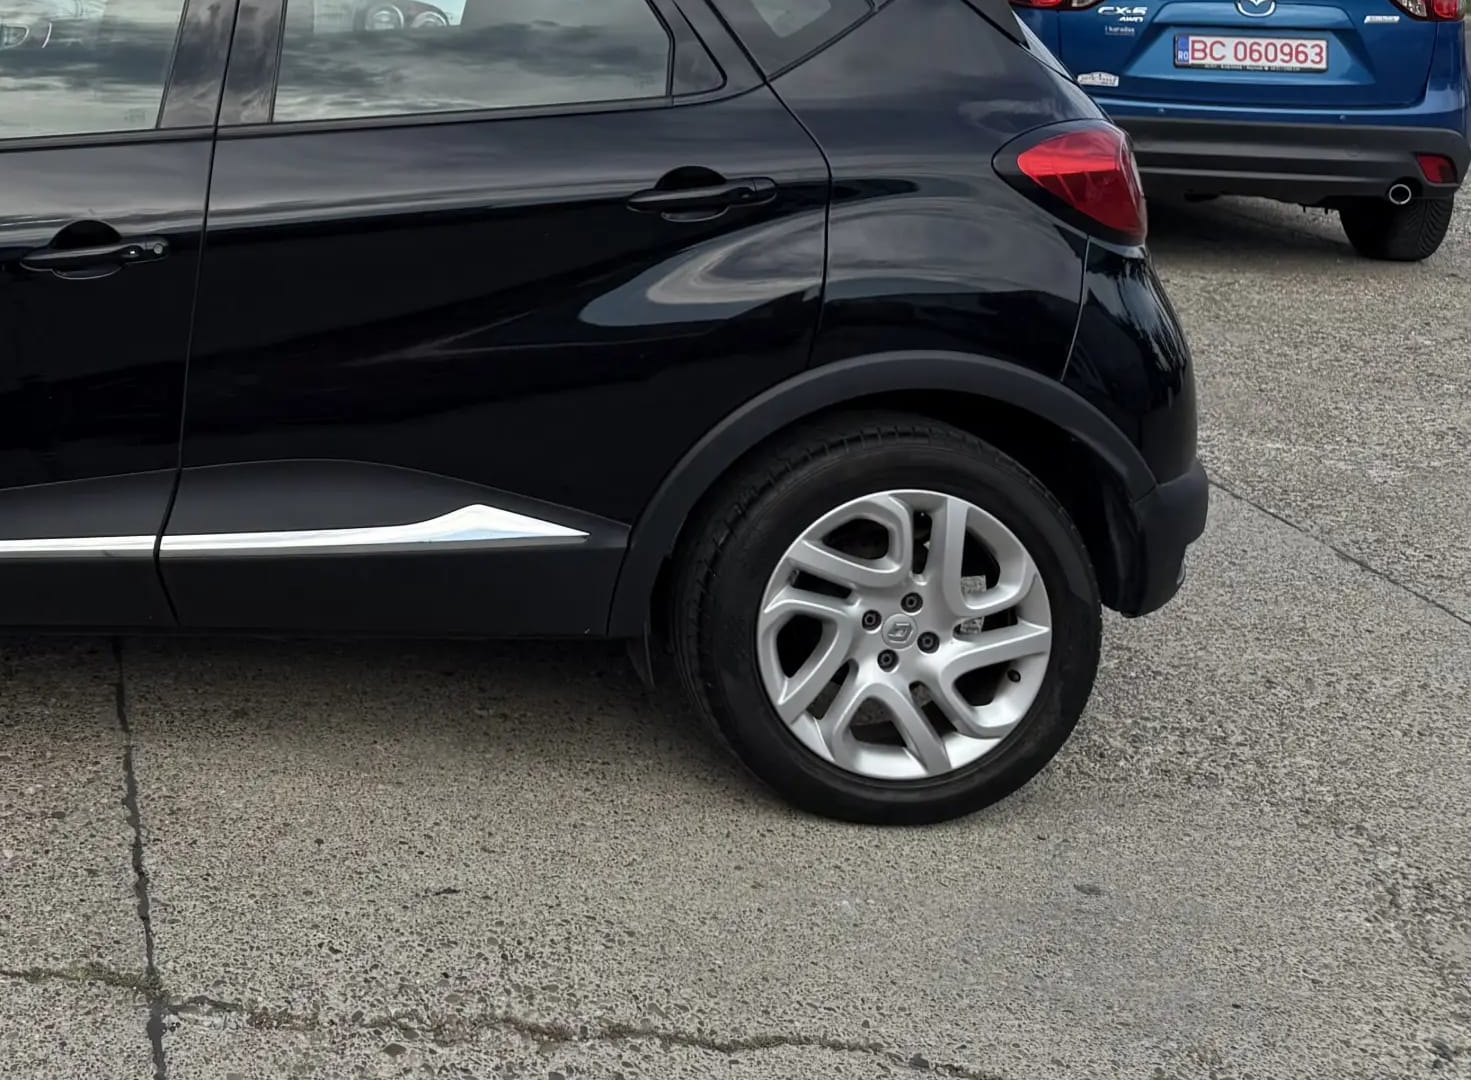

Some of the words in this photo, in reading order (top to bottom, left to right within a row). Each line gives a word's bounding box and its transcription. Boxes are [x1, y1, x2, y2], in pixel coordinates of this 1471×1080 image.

[1178, 50, 1189, 61] RO
[1191, 39, 1226, 62] BC
[1233, 41, 1324, 65] 060963
